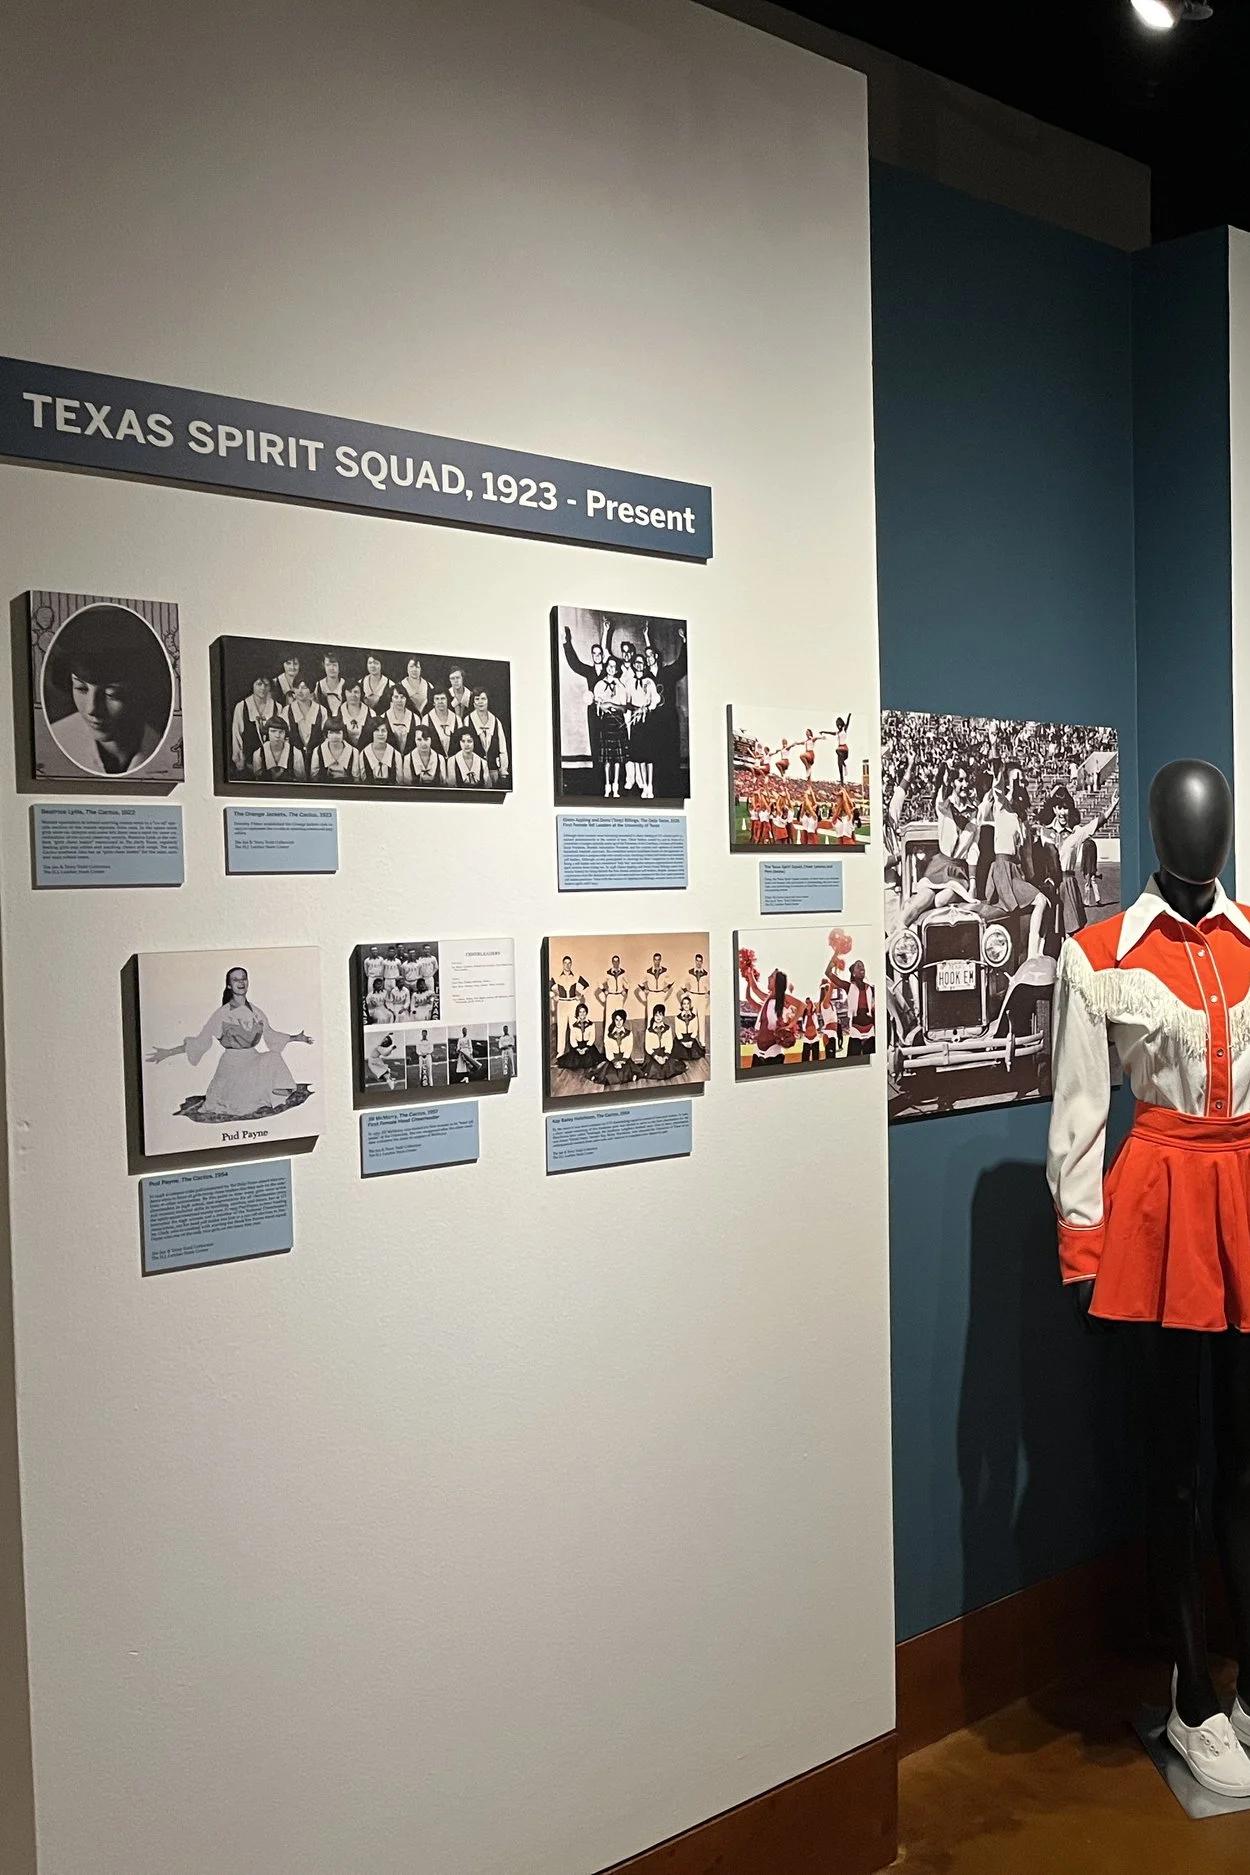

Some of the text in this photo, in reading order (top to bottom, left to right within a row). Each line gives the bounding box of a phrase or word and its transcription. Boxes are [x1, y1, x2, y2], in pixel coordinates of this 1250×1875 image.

[22, 391, 697, 534] TEXAS SPIRIT SQUAD, 1923 - Present
[939, 970, 961, 986] HOOK
[222, 1129, 269, 1142] Pud Payne
